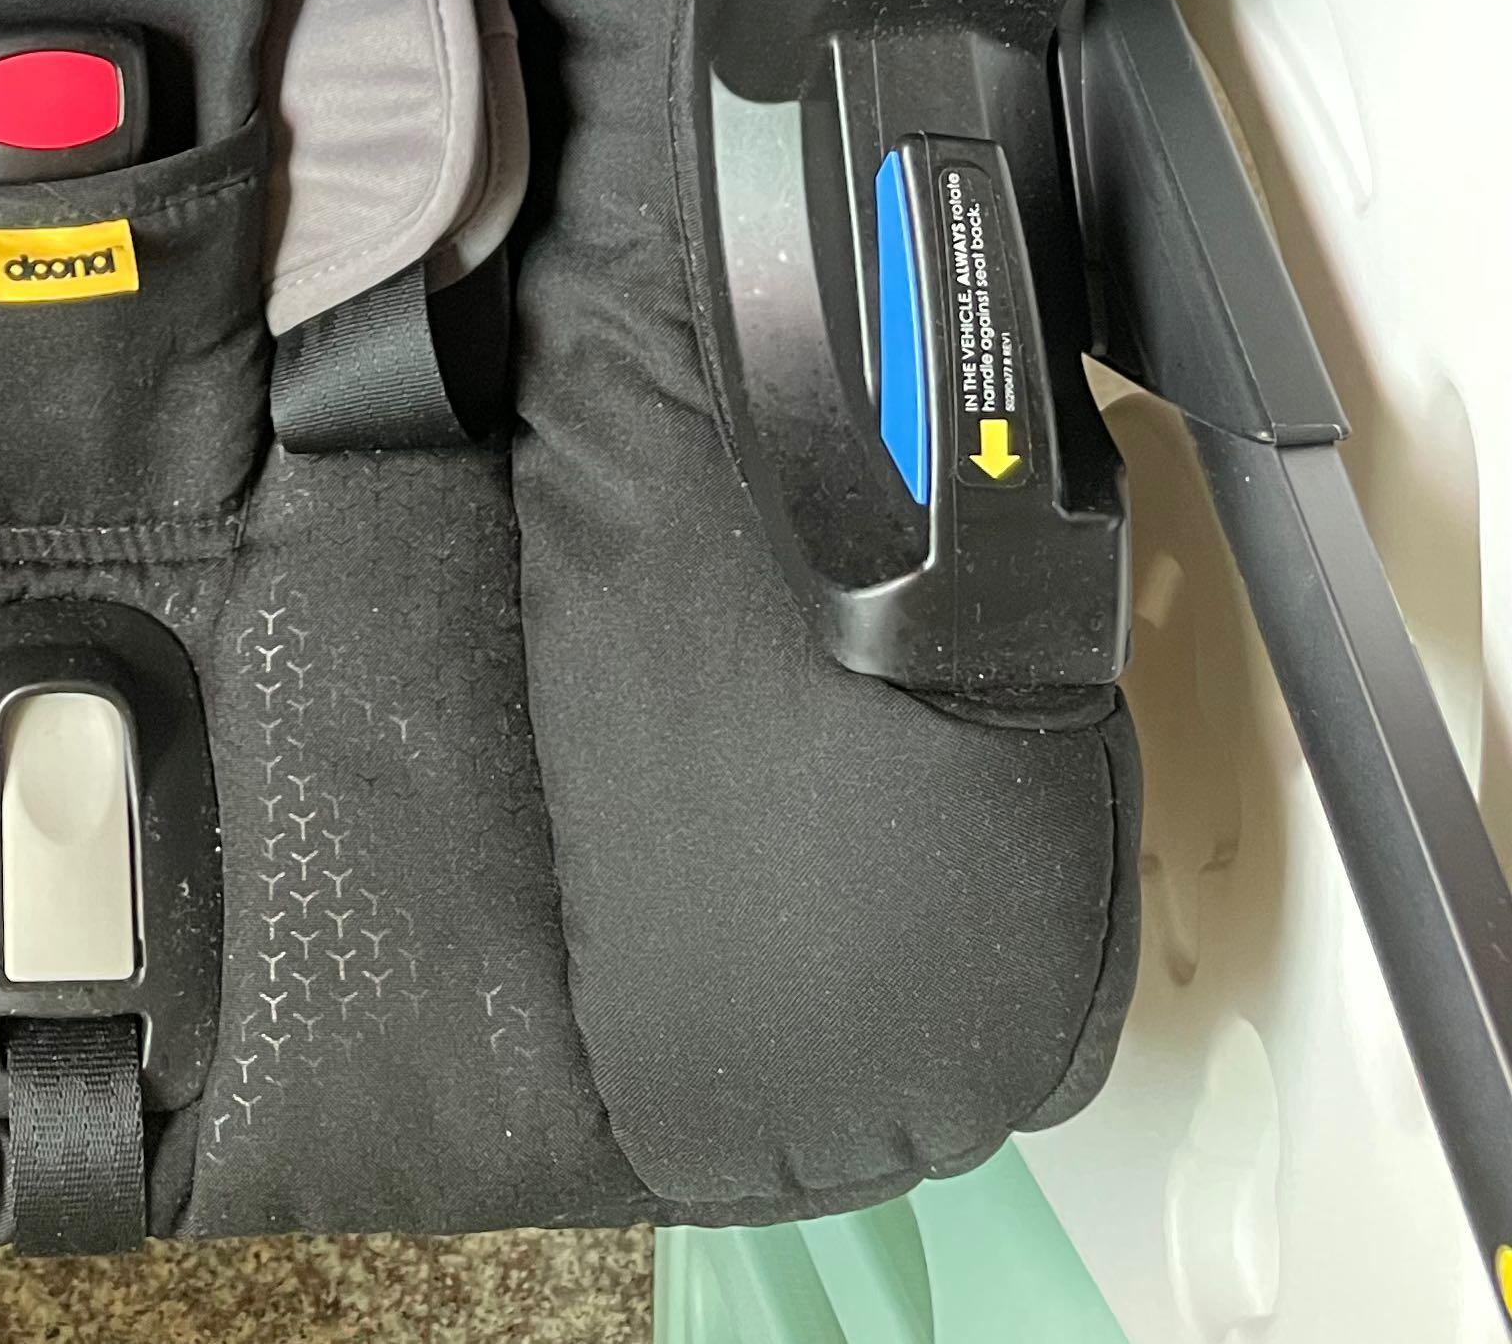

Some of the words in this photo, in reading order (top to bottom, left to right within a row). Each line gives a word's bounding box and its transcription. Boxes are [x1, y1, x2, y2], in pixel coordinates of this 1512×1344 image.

[946, 173, 964, 220] rotate
[967, 203, 984, 249] back.
[4, 247, 116, 281] doona
[951, 223, 970, 286] ALWAYS
[972, 253, 988, 287] seat
[975, 290, 995, 350] against
[963, 363, 976, 391] THE
[979, 353, 995, 411] handle
[964, 395, 978, 411] IN
